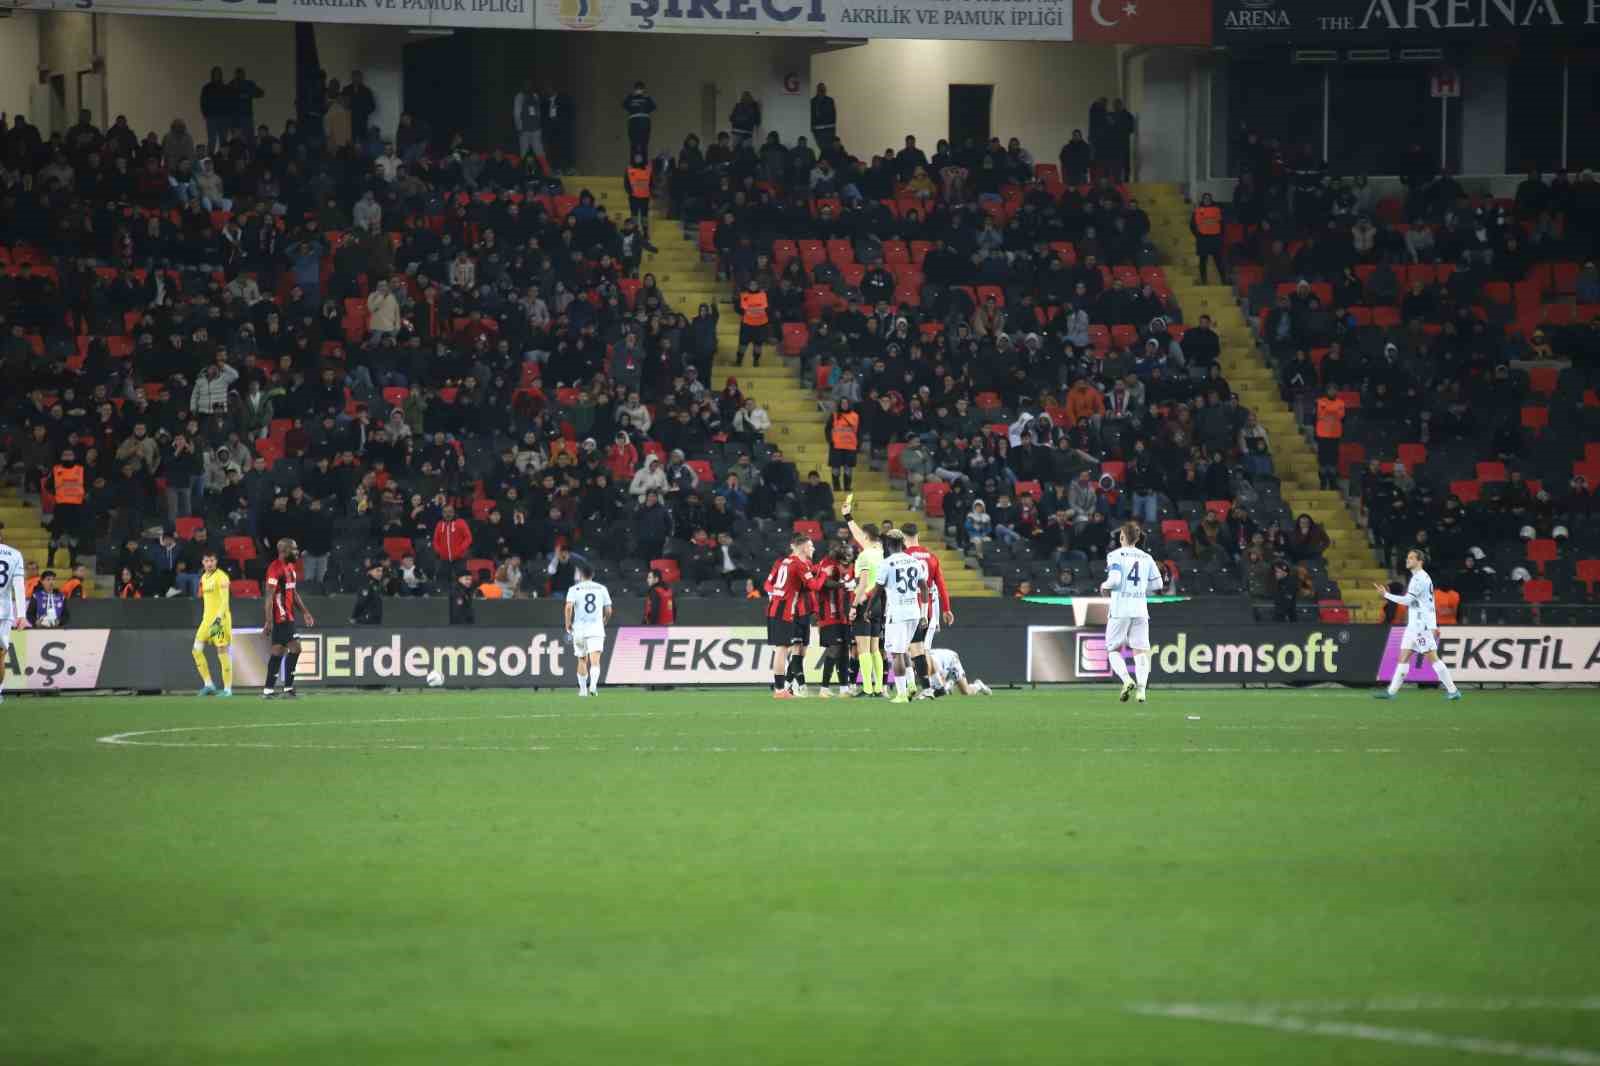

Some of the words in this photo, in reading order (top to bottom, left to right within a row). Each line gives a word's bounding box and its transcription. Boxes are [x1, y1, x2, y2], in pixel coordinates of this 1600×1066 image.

[840, 7, 911, 24] AKRİLİK
[916, 10, 939, 25] VE
[943, 10, 1006, 25] PAMUK
[1011, 8, 1063, 26] İPLİĞİ
[1224, 10, 1291, 26] ARENA
[1318, 16, 1353, 30] THE
[1360, 0, 1564, 29] ARENA
[895, 566, 918, 594] 58
[1127, 561, 1141, 587] 4
[584, 592, 597, 614] 8
[326, 633, 565, 678] Erdemsoft
[639, 638, 776, 671] TEKST
[1145, 632, 1339, 673] rdemsoft
